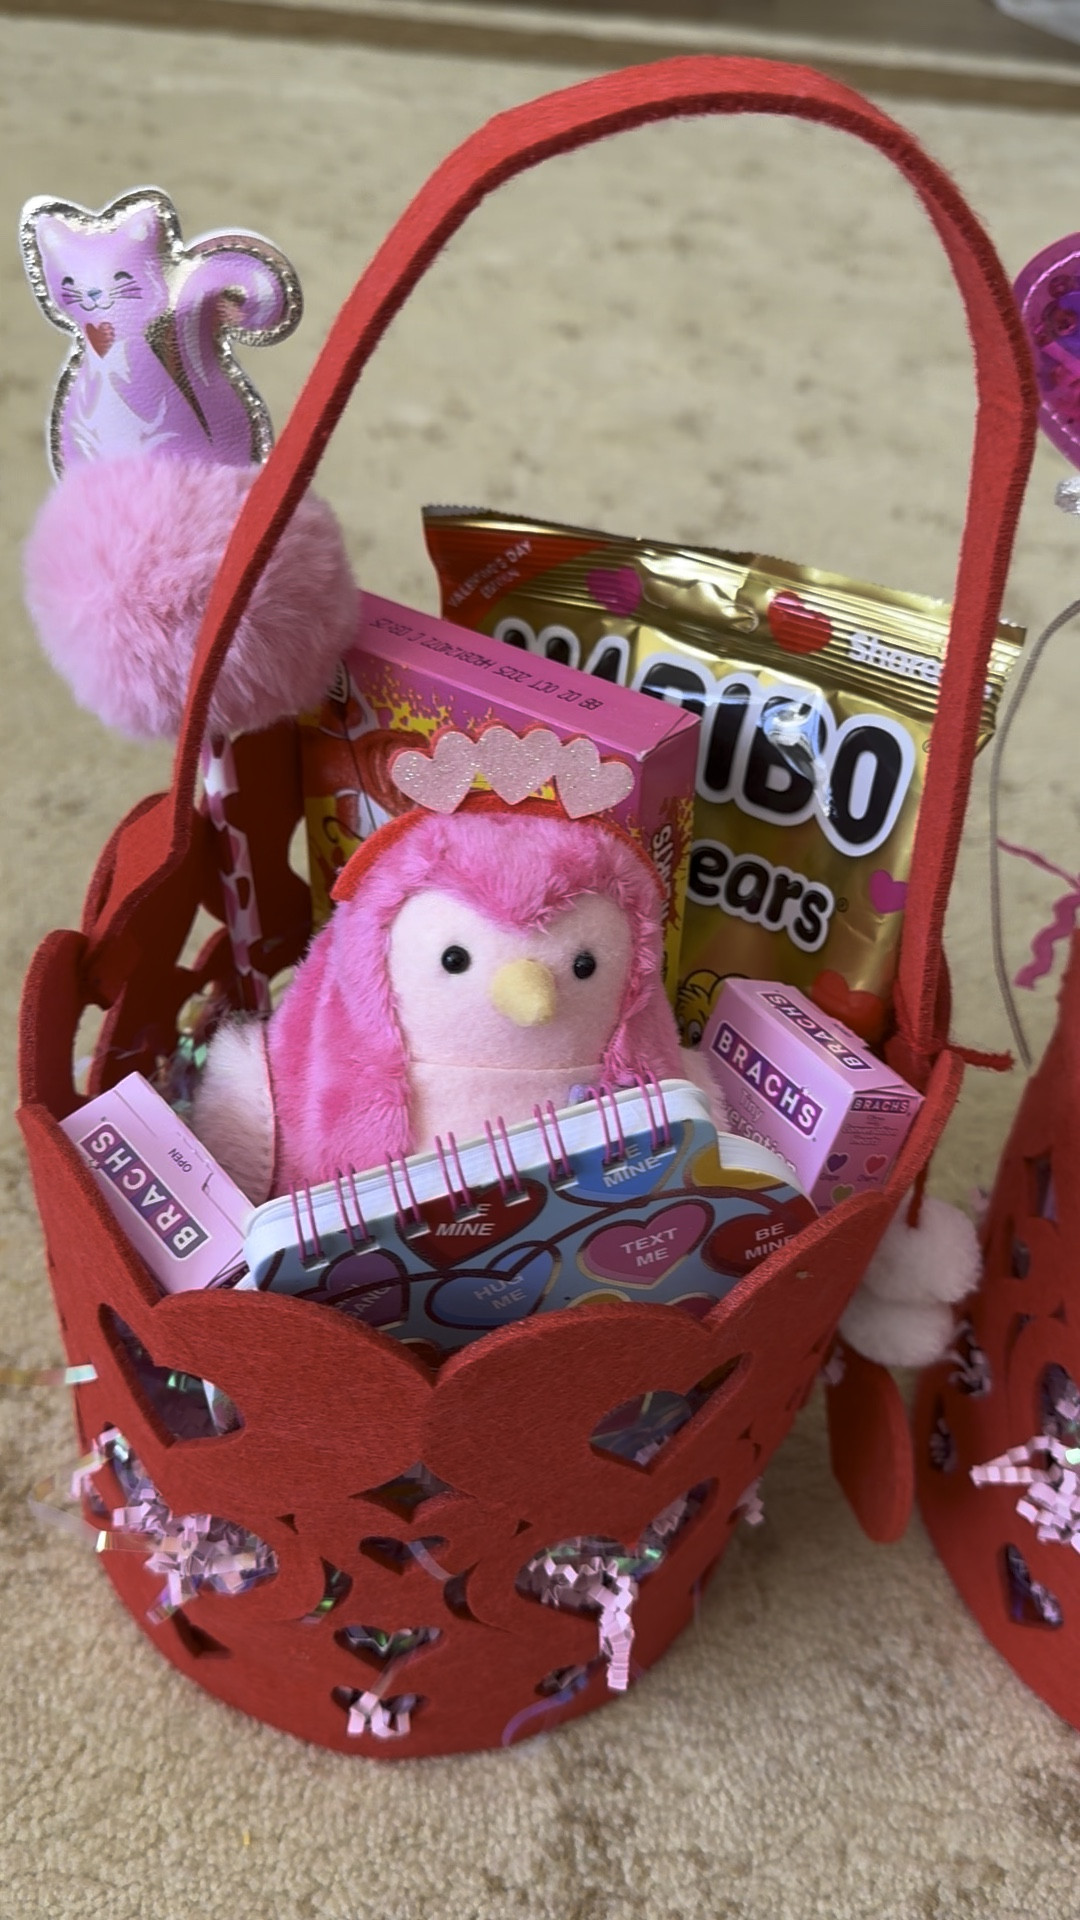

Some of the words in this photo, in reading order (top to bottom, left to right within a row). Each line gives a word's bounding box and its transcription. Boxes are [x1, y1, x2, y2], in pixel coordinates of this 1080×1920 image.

[504, 540, 533, 563] DAY
[492, 665, 532, 684] 2025
[527, 679, 560, 695] OCT
[578, 697, 605, 712] BB
[495, 617, 916, 857] IBO
[687, 839, 836, 953] ears
[767, 994, 862, 1067] BRACHS
[717, 1029, 818, 1129] BRACHS
[741, 1088, 765, 1122] Tiny
[854, 1098, 908, 1114] BRACHS
[167, 1147, 193, 1173] OPEN
[603, 1157, 663, 1188] MINE
[90, 1131, 200, 1251] BRACHS
[435, 1222, 496, 1236] MINE
[620, 1227, 678, 1255] TEXT
[754, 1222, 785, 1241] BE
[636, 1247, 670, 1268] ME
[473, 1273, 526, 1301] HUG
[491, 1288, 528, 1312] ME
